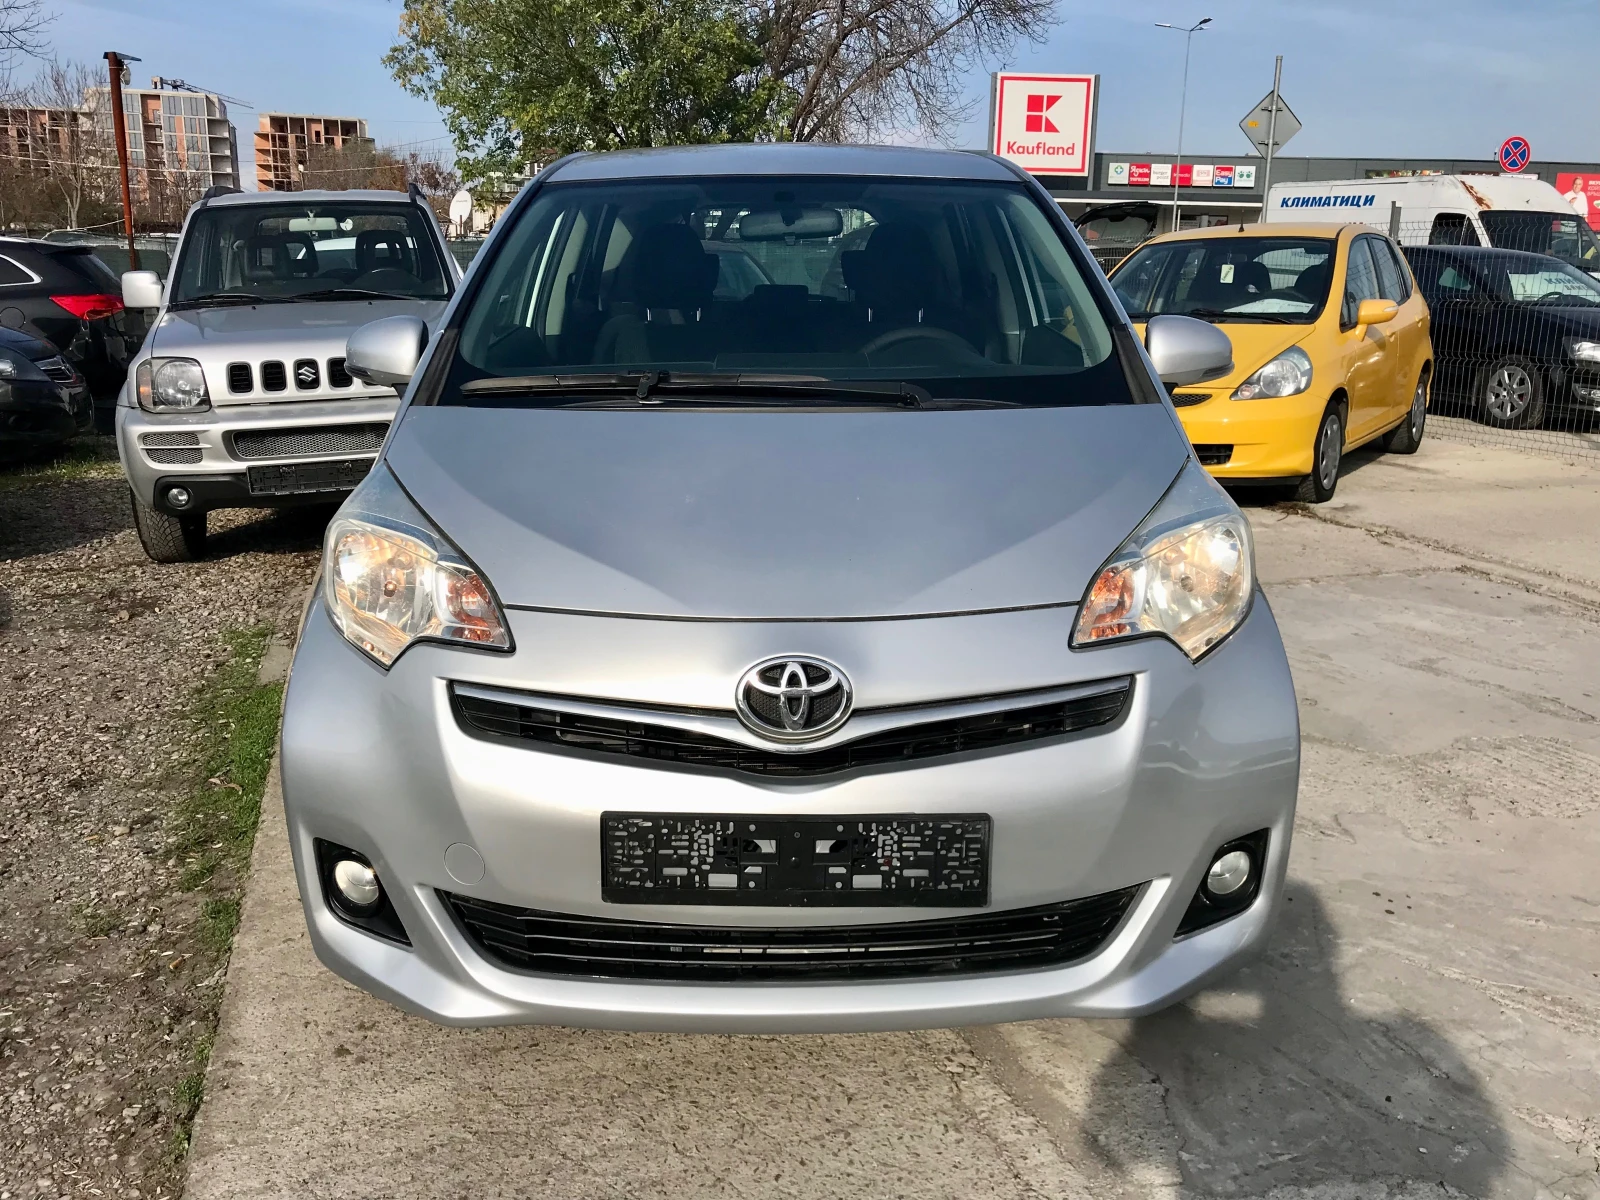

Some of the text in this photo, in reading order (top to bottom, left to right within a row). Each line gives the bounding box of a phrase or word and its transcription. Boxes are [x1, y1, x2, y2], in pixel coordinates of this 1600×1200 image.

[1006, 141, 1075, 156] Kaufland
[1215, 169, 1233, 178] Easy
[1215, 177, 1229, 185] Pay
[1280, 195, 1376, 208] КЛИМАТИЦИ
